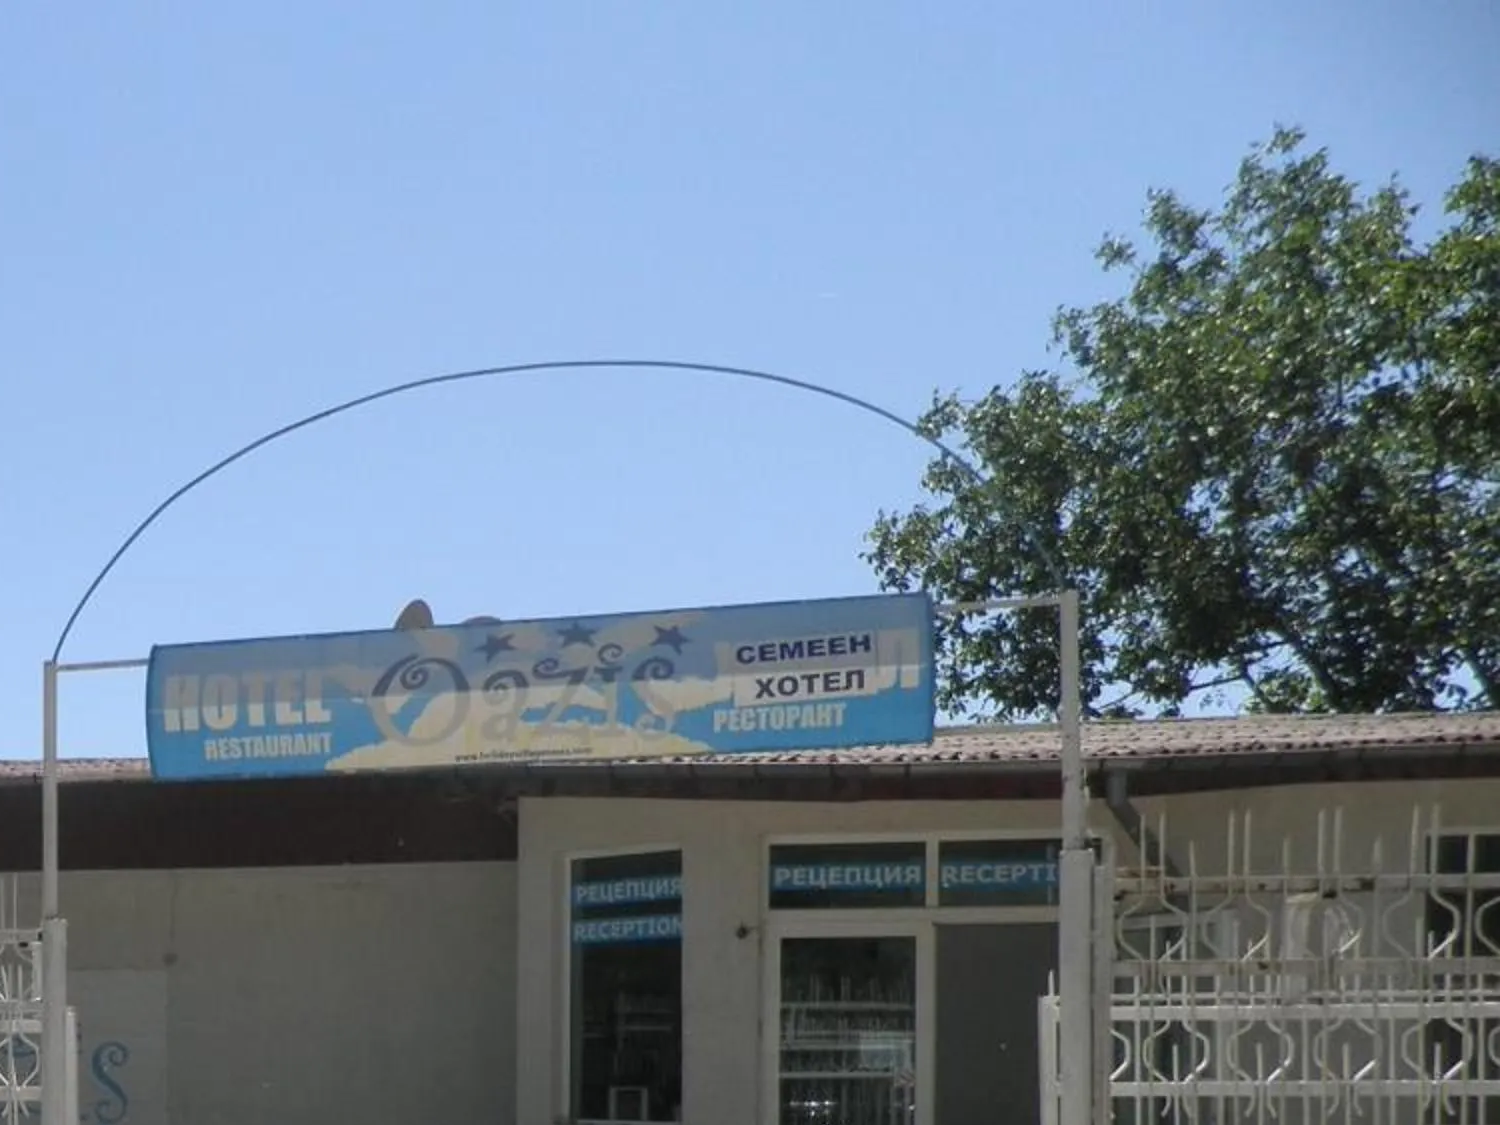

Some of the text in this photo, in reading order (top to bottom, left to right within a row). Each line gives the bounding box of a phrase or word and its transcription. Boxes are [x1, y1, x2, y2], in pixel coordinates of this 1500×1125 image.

[736, 634, 872, 665] СЕМЕЕН
[755, 669, 866, 700] ХОТЕЛ
[164, 669, 332, 733] HOTEL
[713, 703, 847, 733] РЕСТОРАНТ
[204, 733, 332, 761] RESTAURANT
[774, 863, 922, 889] РЕЦЕПЦИЯ
[941, 862, 1058, 887] RECEPTI
[576, 878, 682, 903] РЕЦЕПЦИЯ
